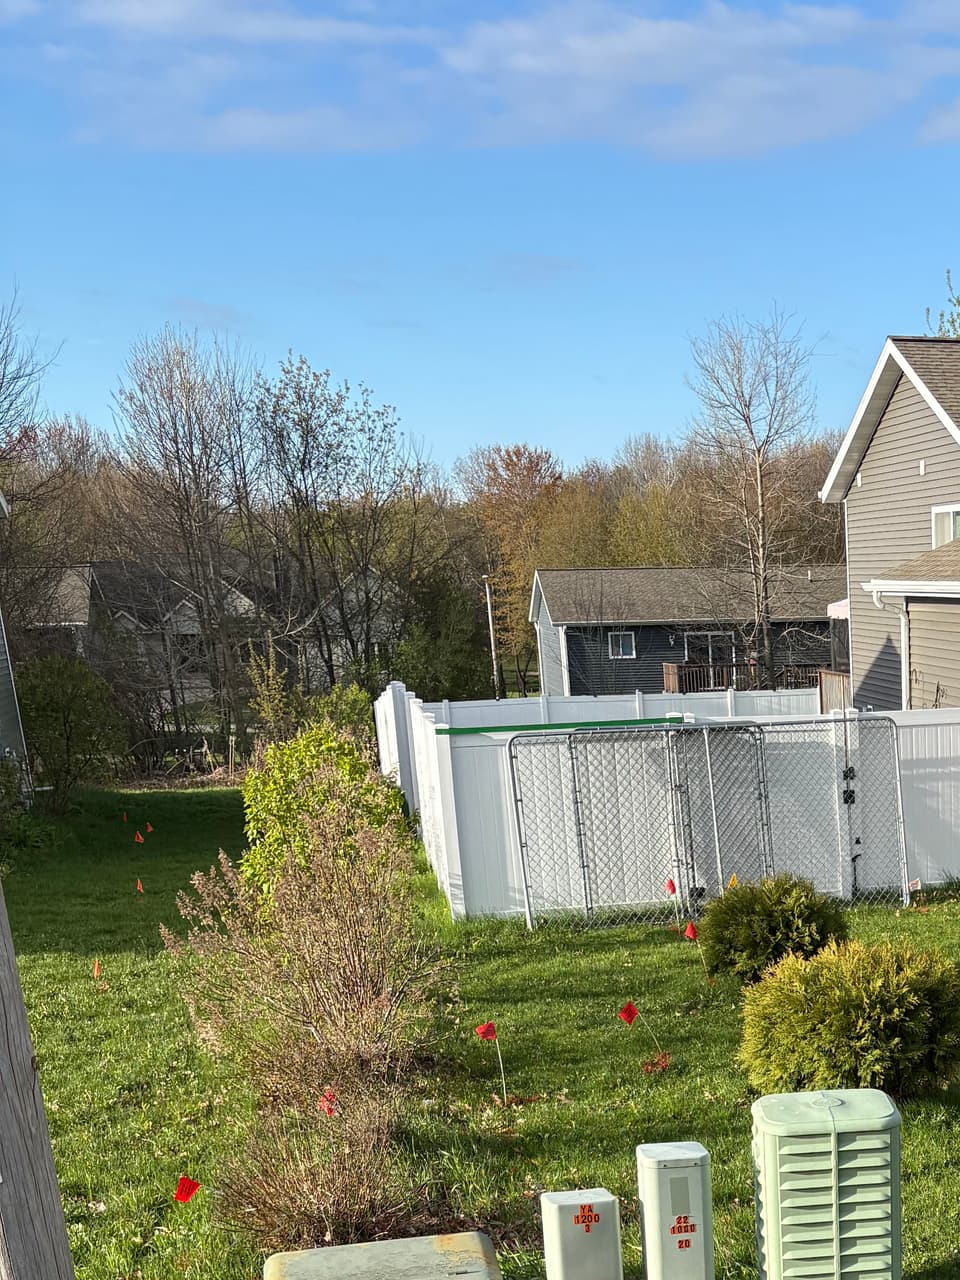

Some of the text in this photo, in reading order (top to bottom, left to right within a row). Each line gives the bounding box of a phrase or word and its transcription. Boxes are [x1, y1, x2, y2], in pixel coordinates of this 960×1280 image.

[580, 1204, 593, 1214] YA
[573, 1214, 600, 1225] 1200
[676, 1215, 689, 1224] 22
[584, 1224, 591, 1233] 3
[670, 1224, 696, 1234] 1000
[677, 1239, 691, 1249] 20
